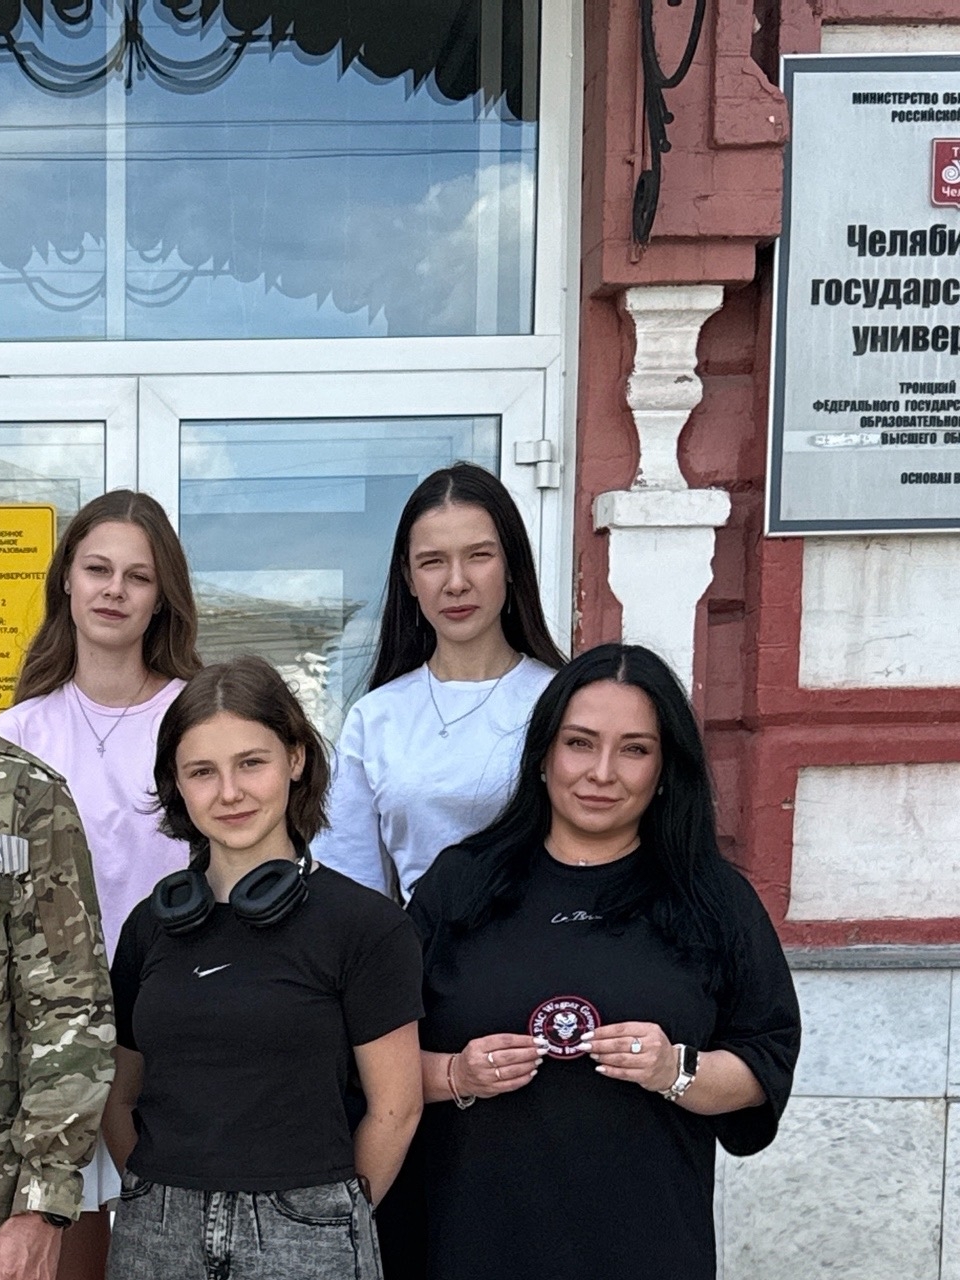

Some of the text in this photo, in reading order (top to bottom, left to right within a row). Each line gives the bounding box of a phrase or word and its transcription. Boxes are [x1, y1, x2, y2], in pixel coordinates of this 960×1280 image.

[852, 92, 939, 105] МИНИСТЕРСТВО
[899, 380, 956, 395] ТРОИЦКИЙ
[813, 400, 900, 414] ФЕДЕРАЛЬНОГО
[860, 416, 960, 428] ОБРАЗОВАТЕЛЬНО
[881, 432, 937, 445] ВЫСШЕГО
[900, 472, 952, 484] ОСНОВАН
